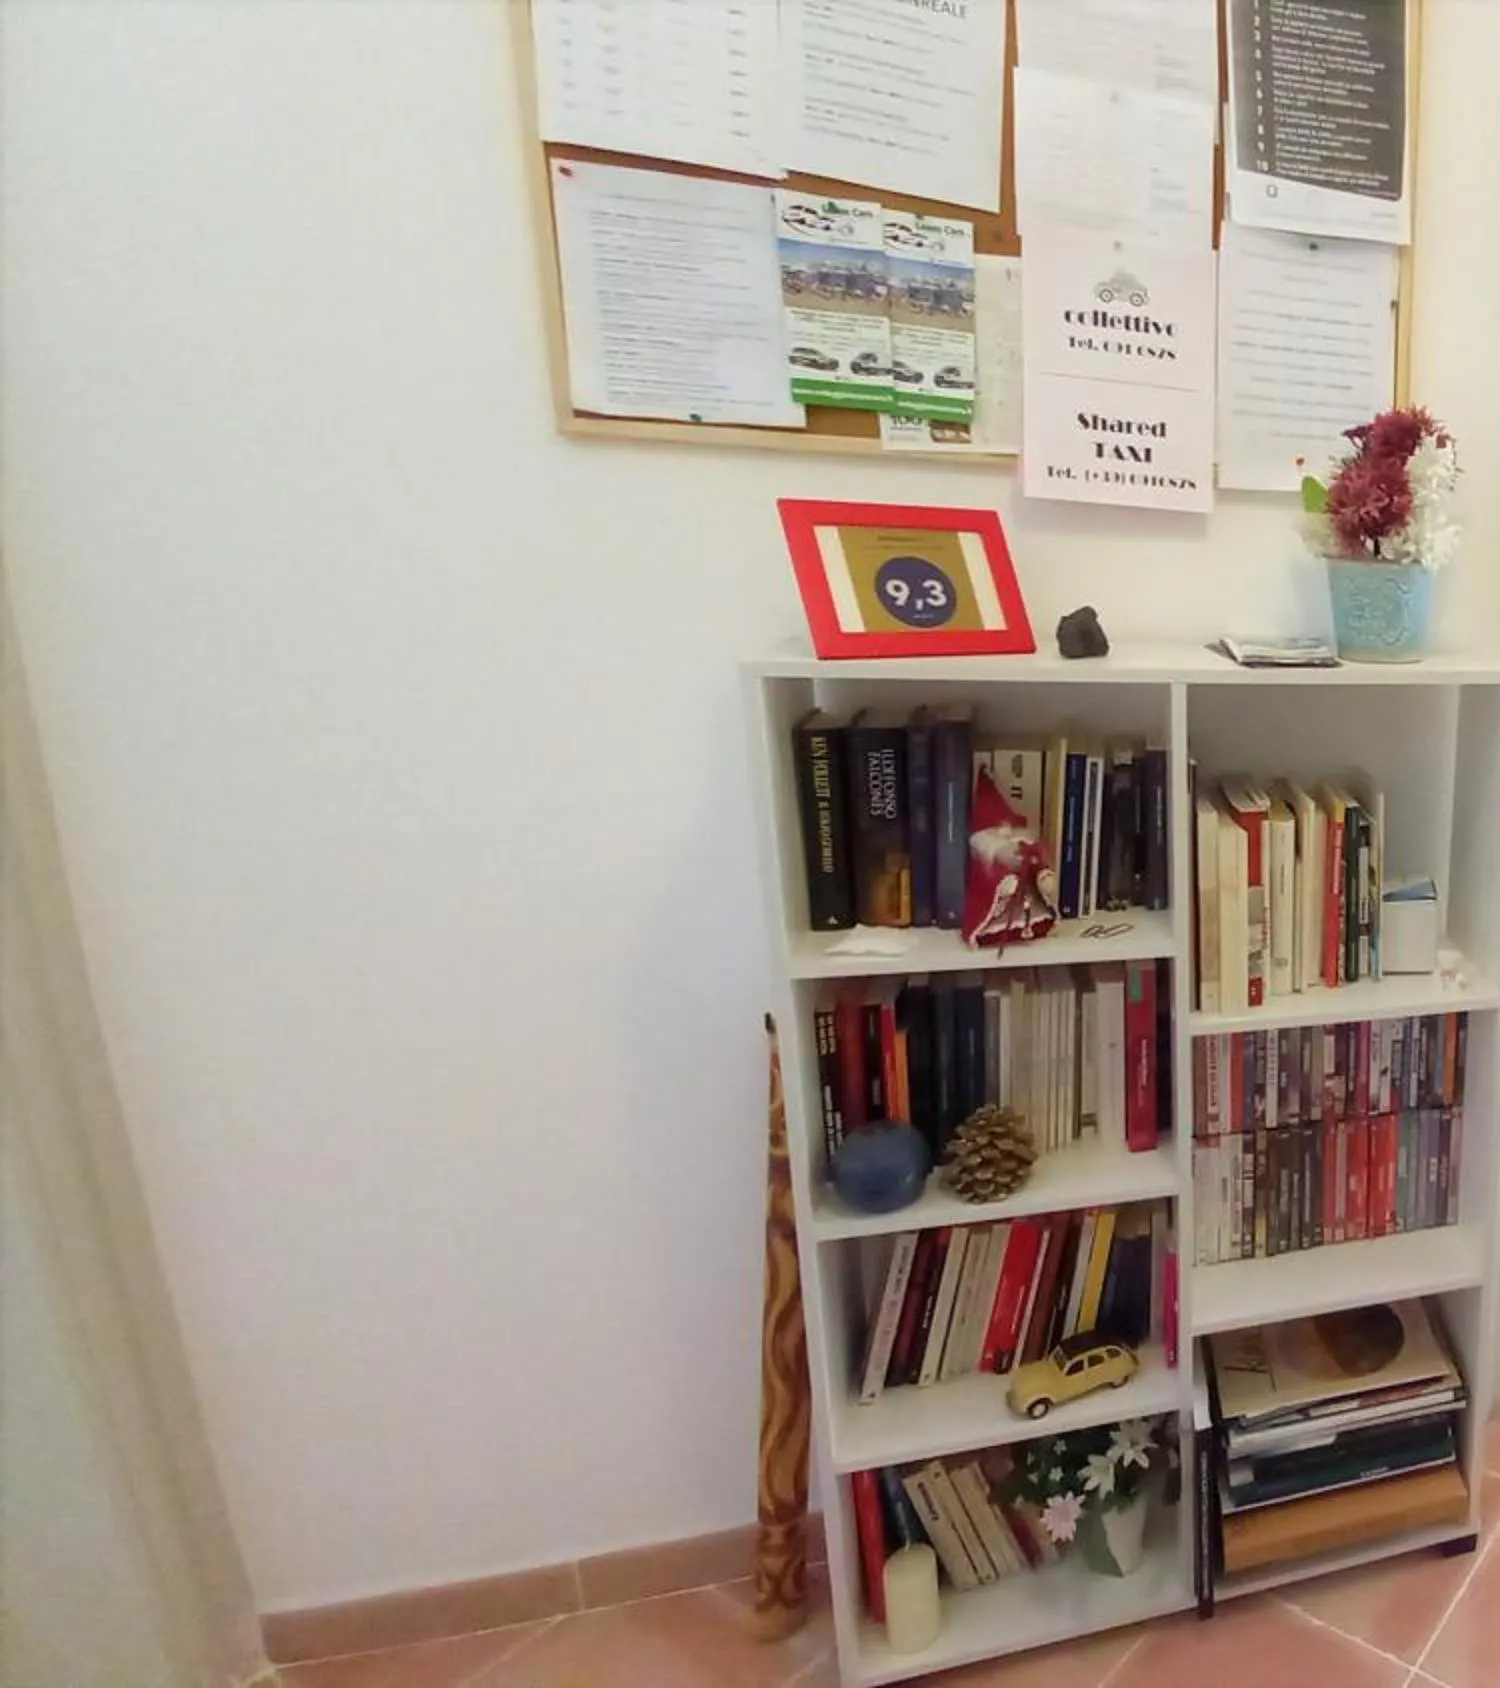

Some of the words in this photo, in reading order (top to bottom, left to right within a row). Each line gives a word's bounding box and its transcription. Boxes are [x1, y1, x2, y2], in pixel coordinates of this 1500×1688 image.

[1256, 160, 1269, 172] 10
[1064, 309, 1179, 337] collettivo
[1068, 336, 1099, 351] Tel.
[1077, 412, 1167, 437] Shared
[1094, 442, 1152, 463] TAXI
[1047, 465, 1077, 480] Tel.
[885, 579, 948, 611] 9,3
[810, 736, 829, 756] KEN
[811, 759, 831, 798] FOLLETT
[868, 752, 885, 817] FALCONES
[880, 749, 897, 819] ILDEFONSO
